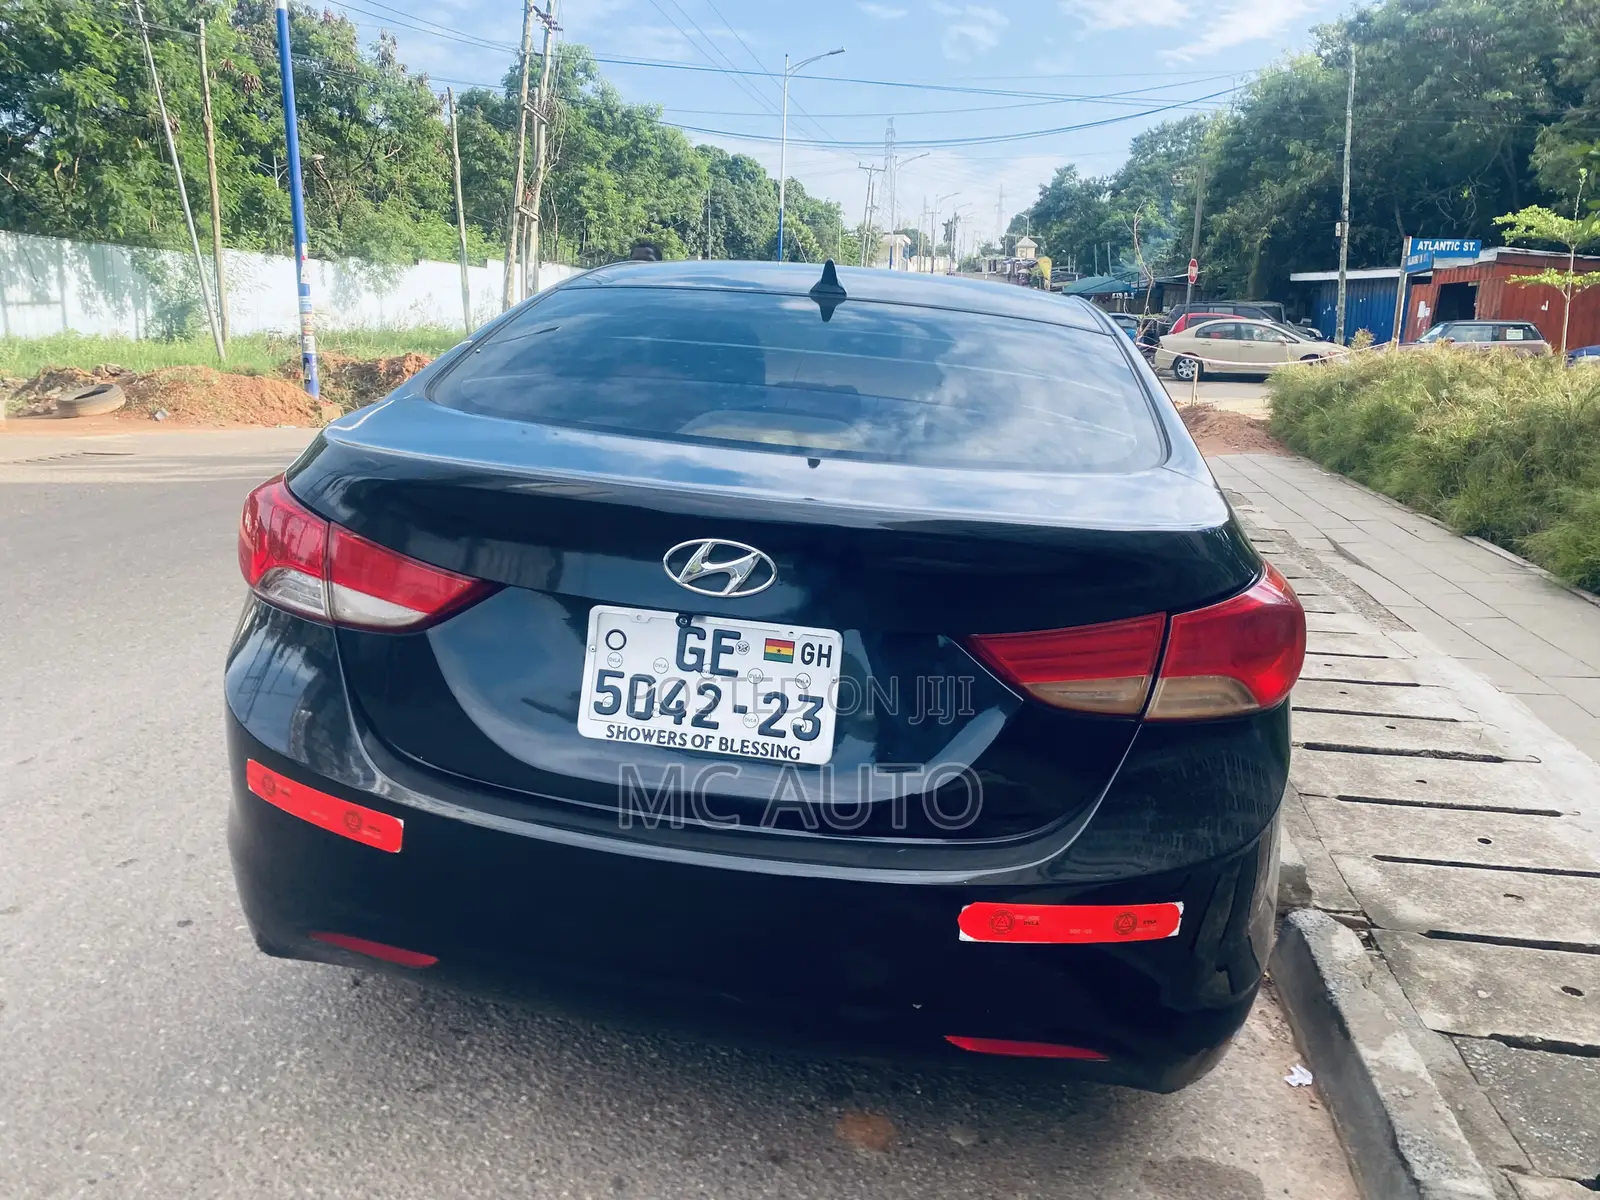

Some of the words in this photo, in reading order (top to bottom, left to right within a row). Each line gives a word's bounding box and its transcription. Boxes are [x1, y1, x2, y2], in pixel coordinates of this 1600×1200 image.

[1417, 241, 1460, 251] ATLANTIC
[1463, 242, 1475, 251] ST.
[676, 625, 741, 678] GE
[801, 642, 832, 668] GH
[606, 724, 688, 747] SHOWERS
[691, 733, 715, 749] OF
[718, 737, 800, 760] BLESSING
